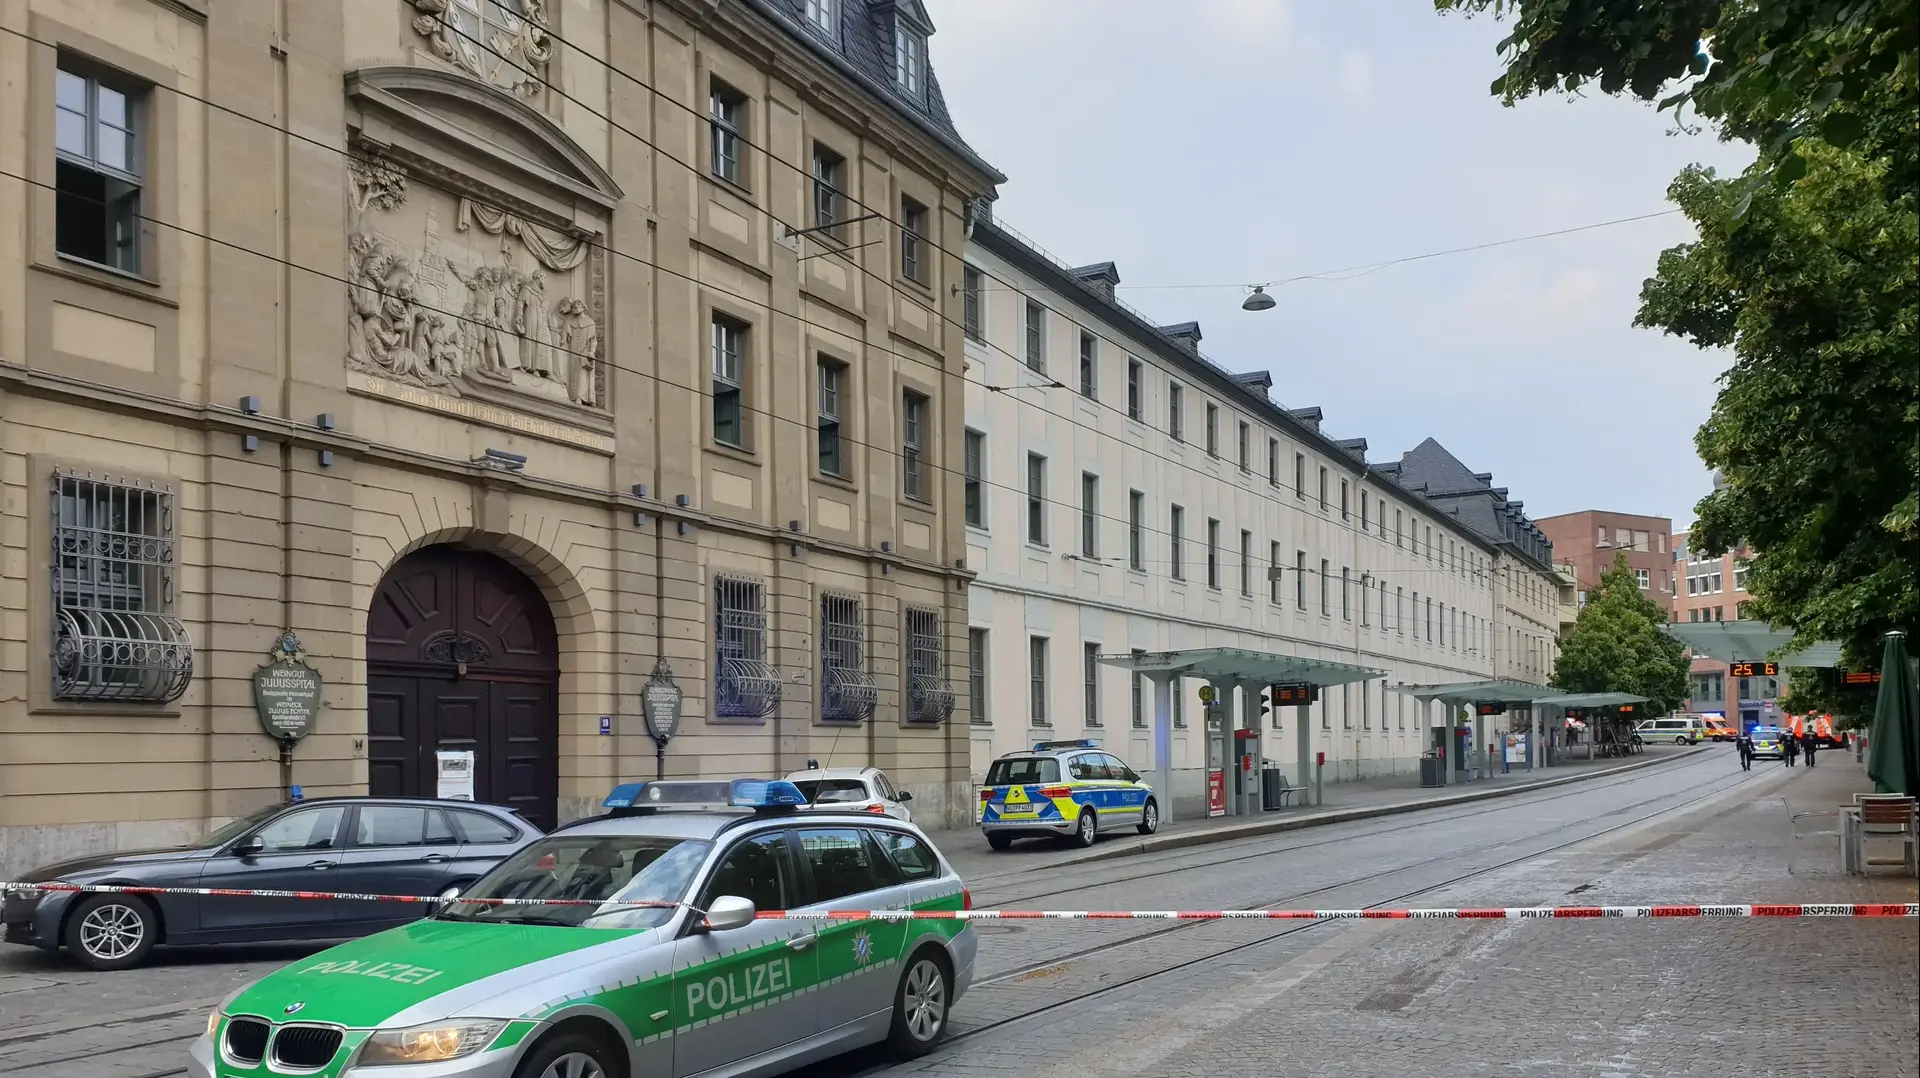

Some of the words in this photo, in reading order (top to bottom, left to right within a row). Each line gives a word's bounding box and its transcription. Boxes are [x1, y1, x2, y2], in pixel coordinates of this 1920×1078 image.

[272, 669, 306, 678] WEINGUT
[260, 677, 317, 689] JULIUSSPITAL
[1121, 792, 1138, 802] POLIZEI
[1637, 907, 1743, 917] POLIZEIABSPERRUNG
[1757, 906, 1867, 916] POLIZEIABSPERRUNG
[1881, 905, 1919, 916] POLIZE
[296, 960, 445, 985] POLIZEI
[686, 957, 792, 1018] POLIZEI
